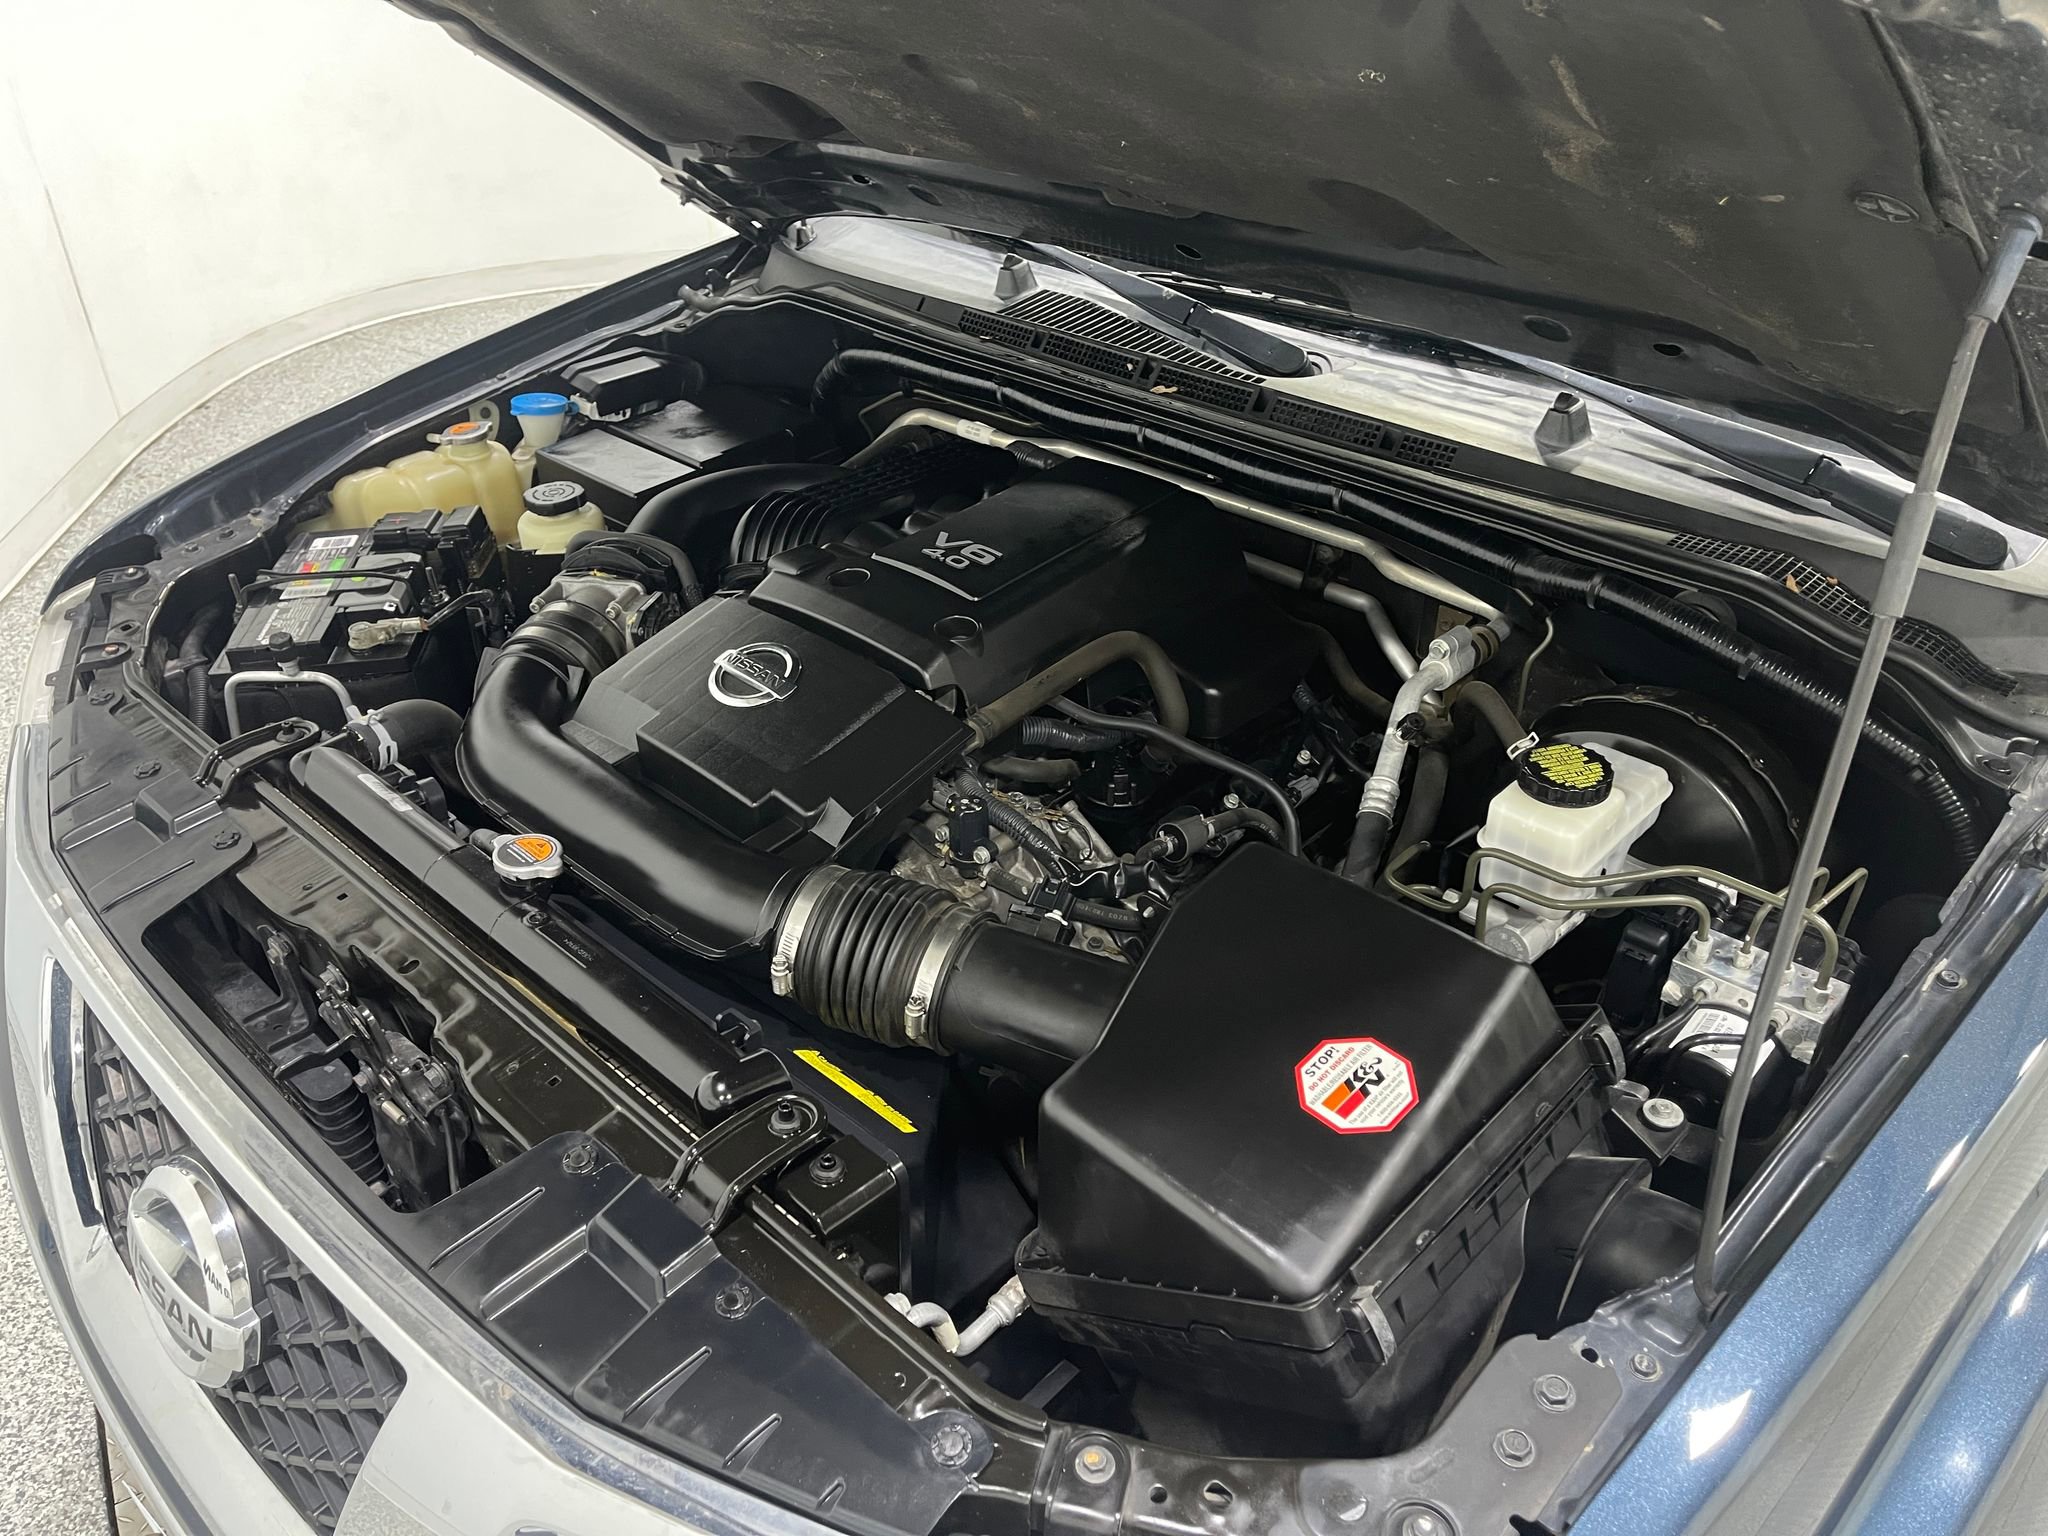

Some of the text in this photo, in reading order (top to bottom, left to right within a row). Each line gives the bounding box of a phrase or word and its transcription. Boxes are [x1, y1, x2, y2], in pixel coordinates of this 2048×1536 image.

[921, 548, 970, 569] 4.0
[936, 531, 1003, 565] V6
[722, 652, 787, 690] NISSAN
[1305, 1046, 1339, 1078] STOP!
[1308, 1046, 1355, 1092] DO NOT DISCARD
[1344, 1057, 1386, 1100] K&N
